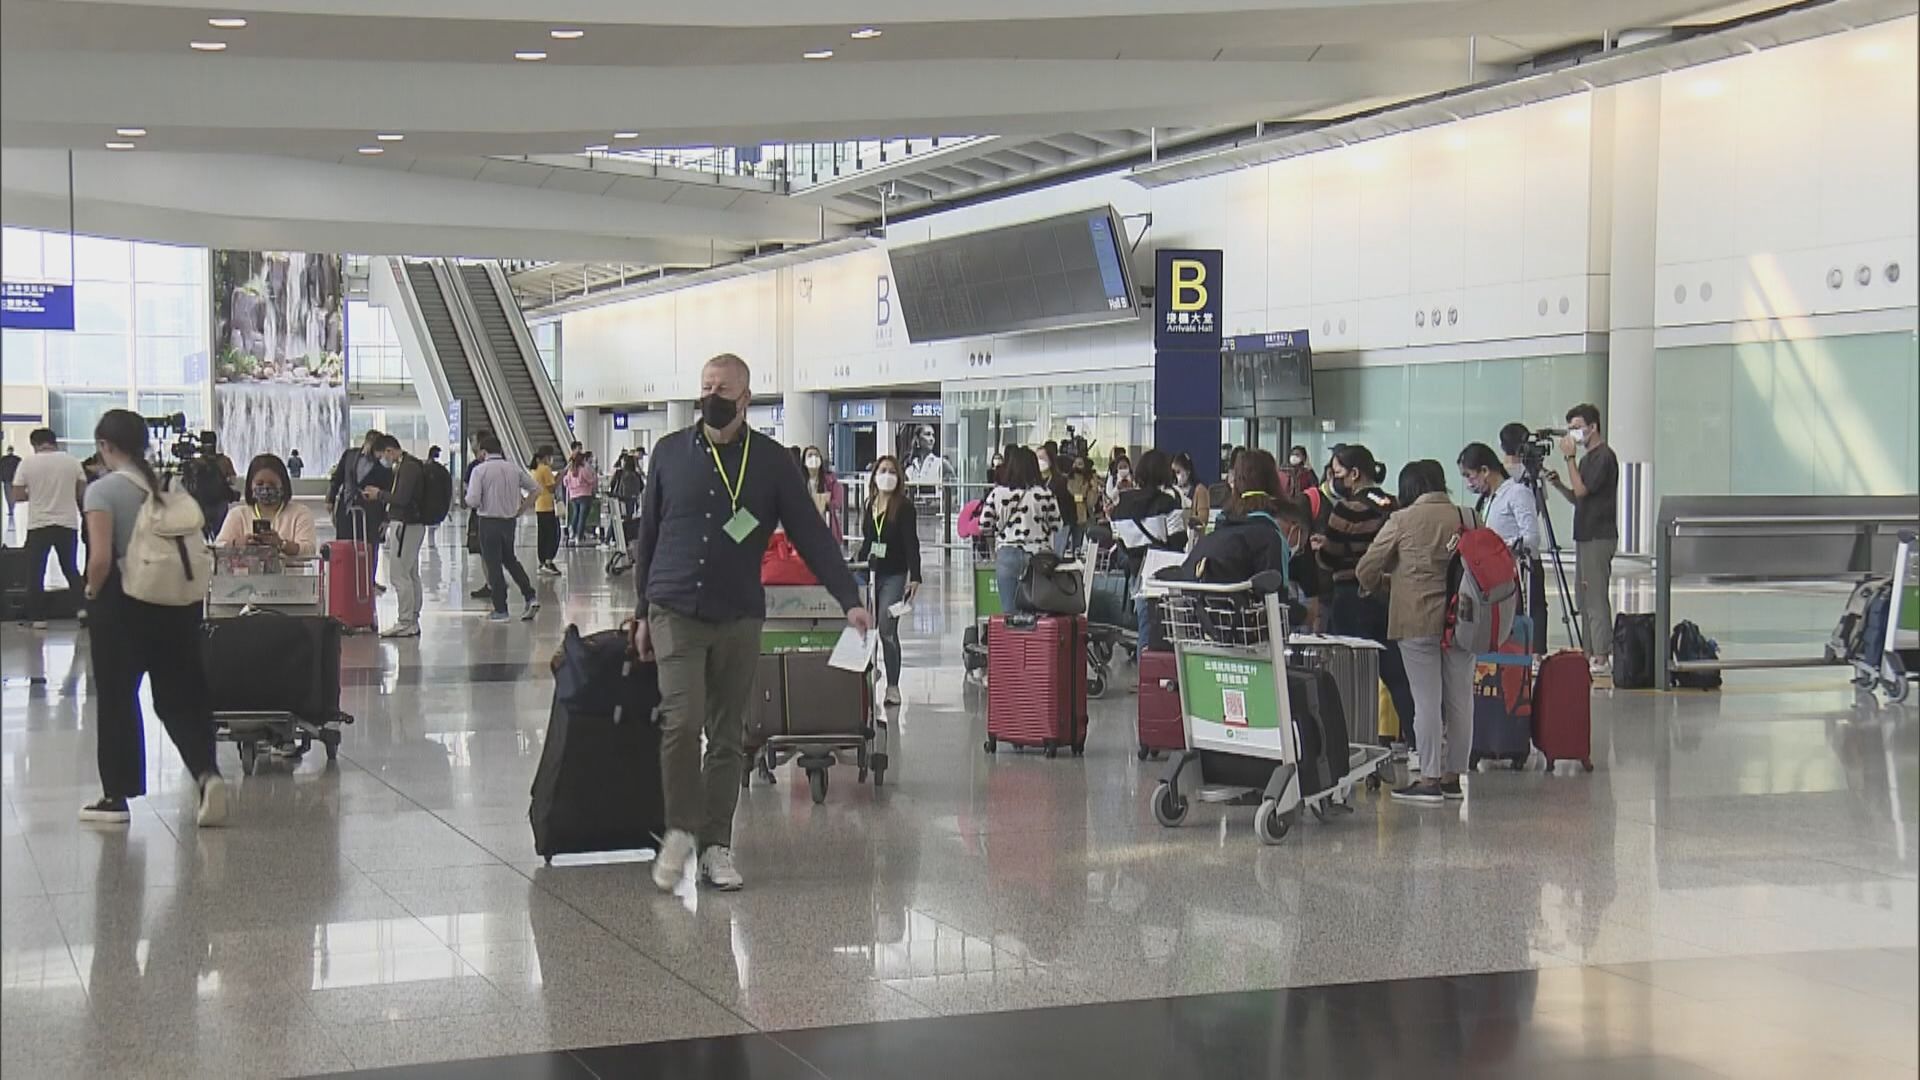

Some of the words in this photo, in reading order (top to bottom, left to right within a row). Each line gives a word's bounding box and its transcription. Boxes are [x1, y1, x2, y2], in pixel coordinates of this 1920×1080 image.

[877, 276, 890, 326] B
[1172, 259, 1208, 311] B
[1166, 324, 1196, 332] Arrivals
[1198, 323, 1214, 332] Hall
